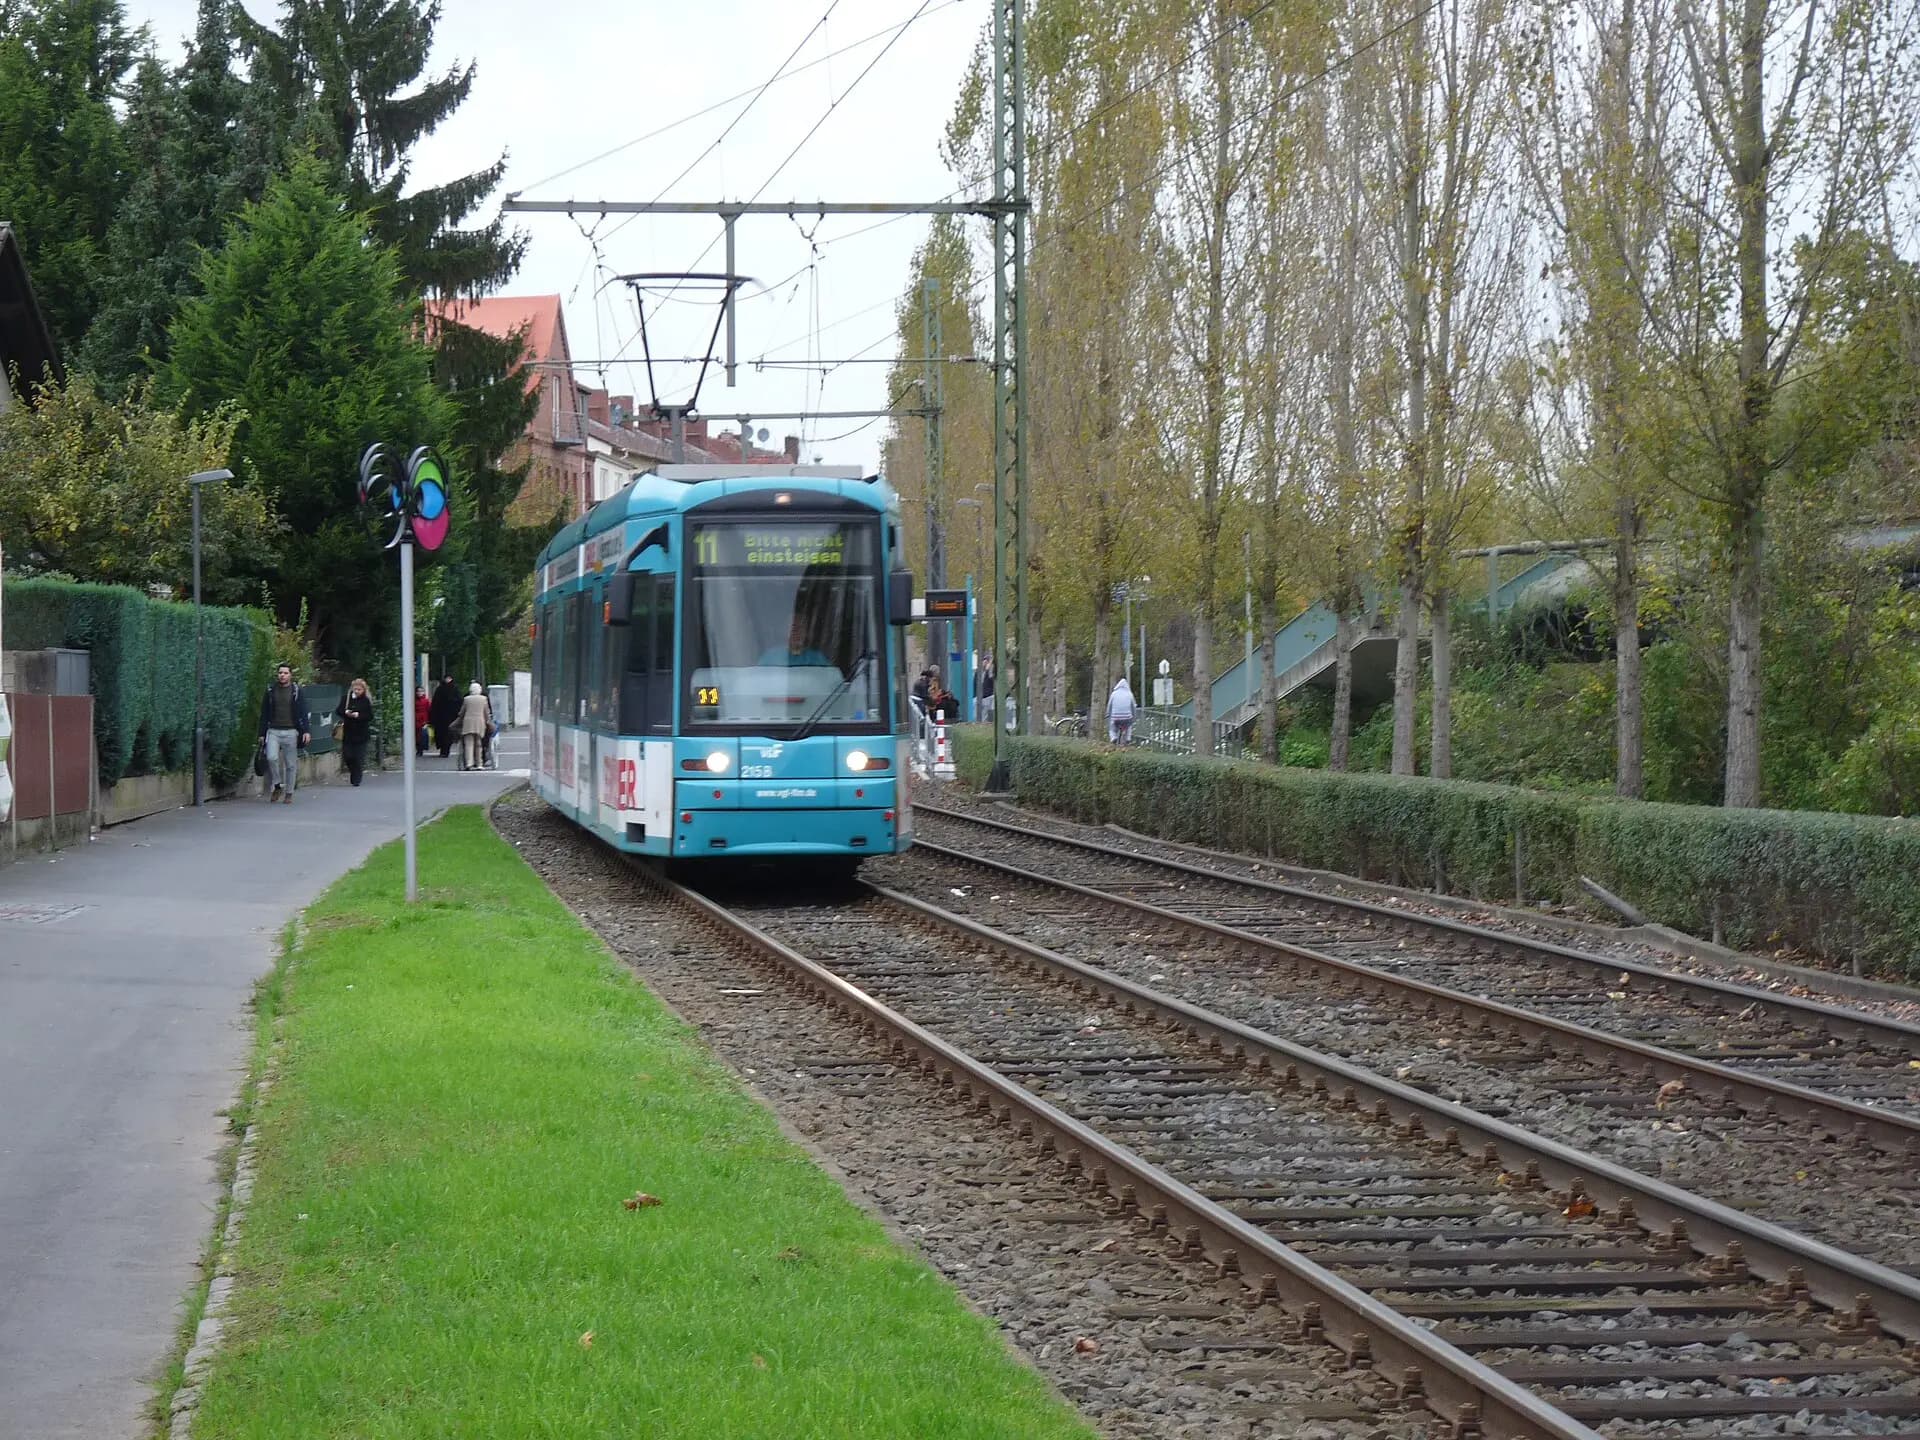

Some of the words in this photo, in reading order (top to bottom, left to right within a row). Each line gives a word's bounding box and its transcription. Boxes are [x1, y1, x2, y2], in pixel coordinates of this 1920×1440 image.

[693, 531, 718, 564] 11
[744, 533, 791, 547] Bitte
[798, 533, 844, 547] nicht
[747, 548, 841, 563] einsteigen
[698, 687, 719, 704] 11
